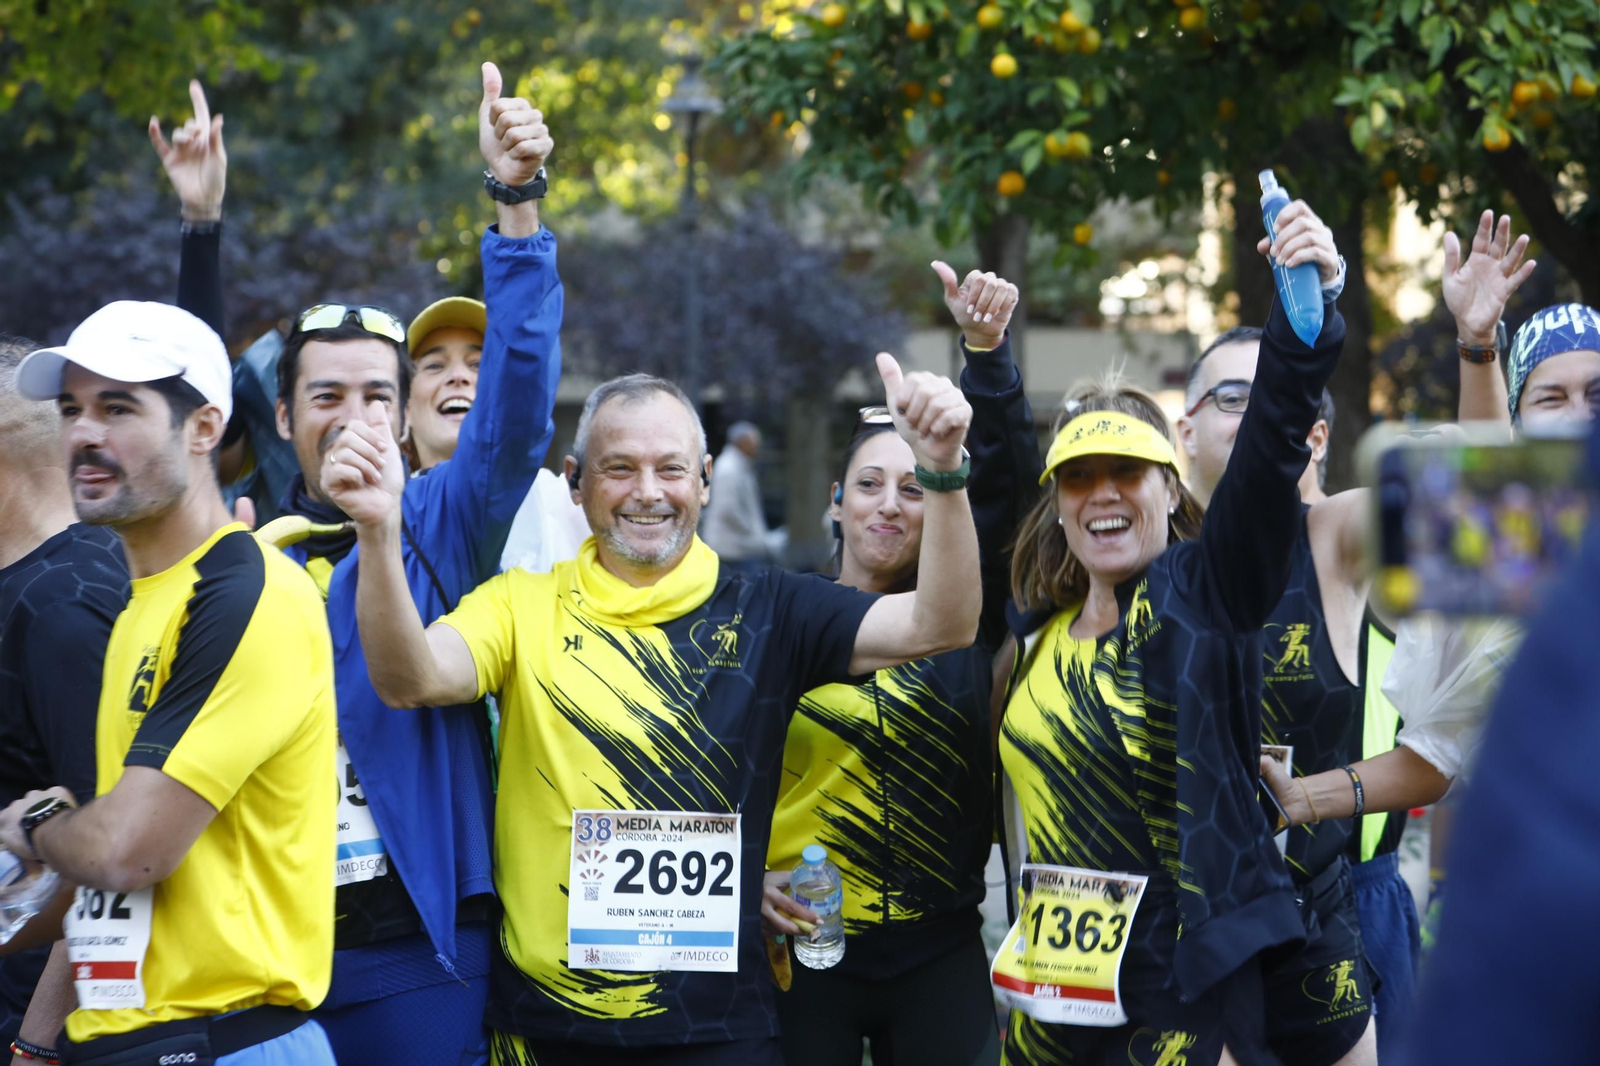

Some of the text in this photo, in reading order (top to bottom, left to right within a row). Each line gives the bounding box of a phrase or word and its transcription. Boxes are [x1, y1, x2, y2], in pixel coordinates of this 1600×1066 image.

[577, 816, 734, 842] 38 MEDIA MARATÓN
[661, 833, 683, 842] 2024
[613, 848, 734, 896] 2692
[1036, 872, 1064, 886] MEDIA
[606, 907, 706, 919] RUBEN SANCHEZ CABEZA
[1030, 902, 1128, 954] 1363
[638, 931, 673, 945] CAJÓN 4
[683, 951, 729, 962] IMDECO
[159, 1052, 196, 1066] eono
